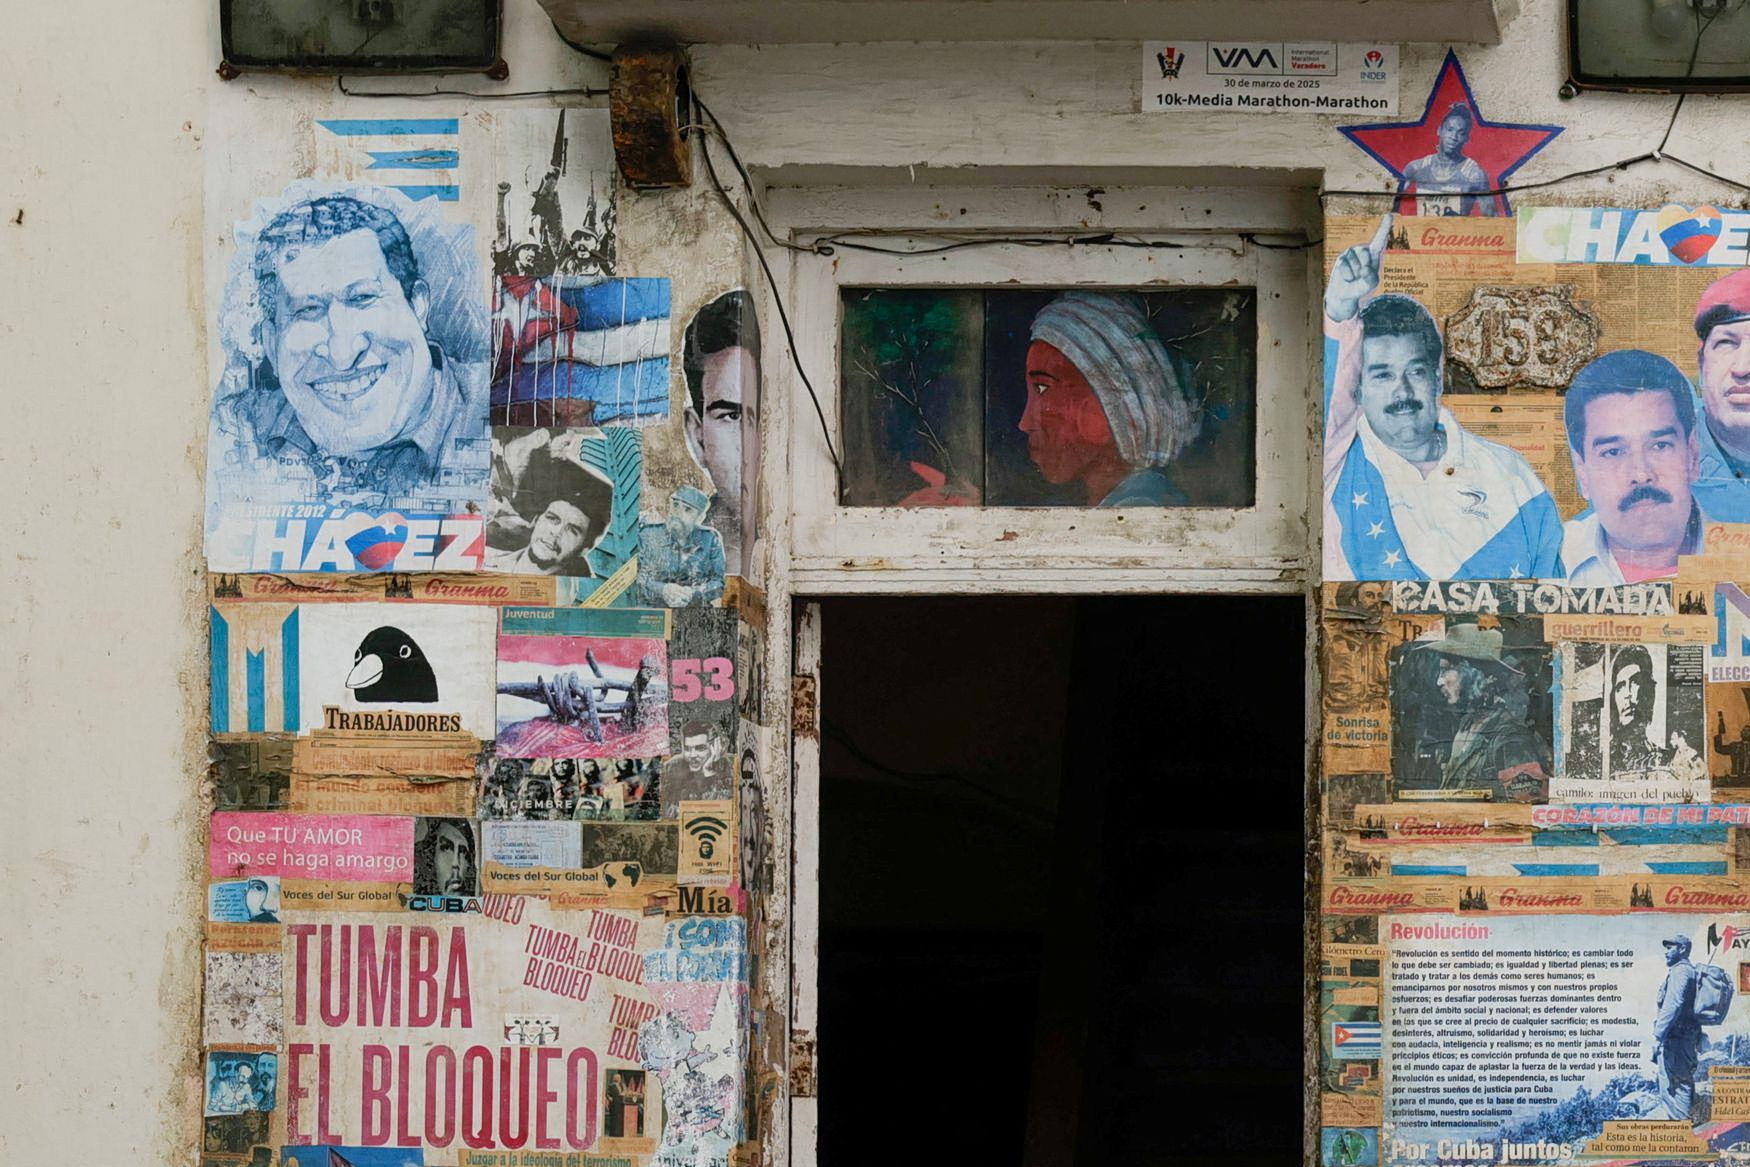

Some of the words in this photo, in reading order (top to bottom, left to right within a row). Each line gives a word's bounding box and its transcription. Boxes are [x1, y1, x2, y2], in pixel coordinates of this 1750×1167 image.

[1224, 79, 1236, 87] 30
[1239, 79, 1249, 88] de
[1252, 80, 1280, 88] marzo
[1284, 80, 1295, 88] de
[1298, 80, 1320, 88] 2025
[1361, 72, 1386, 80] INDER
[1157, 94, 1233, 106] 10k-Media
[1238, 95, 1388, 108] Marathon-Marathon
[1421, 227, 1505, 247] Granma
[297, 505, 325, 517] 2012
[425, 579, 509, 599] Granma
[1393, 583, 1499, 614] CASA
[1516, 584, 1673, 615] TOMADA
[504, 608, 555, 620] Juventud
[1552, 621, 1642, 638] guerrillero
[671, 657, 735, 701] 53
[1336, 715, 1380, 728] Sonrisa
[1327, 731, 1342, 740] de
[1345, 729, 1388, 742] victoria
[1532, 805, 1639, 825] CORAZÓN
[1644, 806, 1672, 824] DE
[226, 826, 267, 845] Que
[272, 826, 298, 844] TU
[304, 827, 362, 845] AMOR
[227, 850, 251, 865] no
[256, 851, 278, 865] se
[282, 848, 330, 871] haga
[335, 852, 408, 871] amargo
[491, 872, 523, 881] Voces
[527, 872, 541, 880] del
[544, 872, 561, 880] Sur
[565, 872, 598, 881] Global
[409, 897, 482, 913] CUBA
[677, 887, 733, 913] Mía
[1330, 887, 1414, 905] Granma
[1500, 888, 1584, 907] Granma
[1666, 887, 1750, 904] Granma
[587, 910, 639, 948] TUMBA
[525, 924, 578, 966] TUMBA
[576, 950, 587, 969] EL
[287, 925, 473, 1029] TUMBA
[523, 958, 592, 1001] BLOQUEO
[288, 1044, 342, 1147] EL
[362, 1045, 600, 1151] BLOQUEO
[1437, 1140, 1494, 1160] Cuba
[1501, 1140, 1571, 1162] juntos
